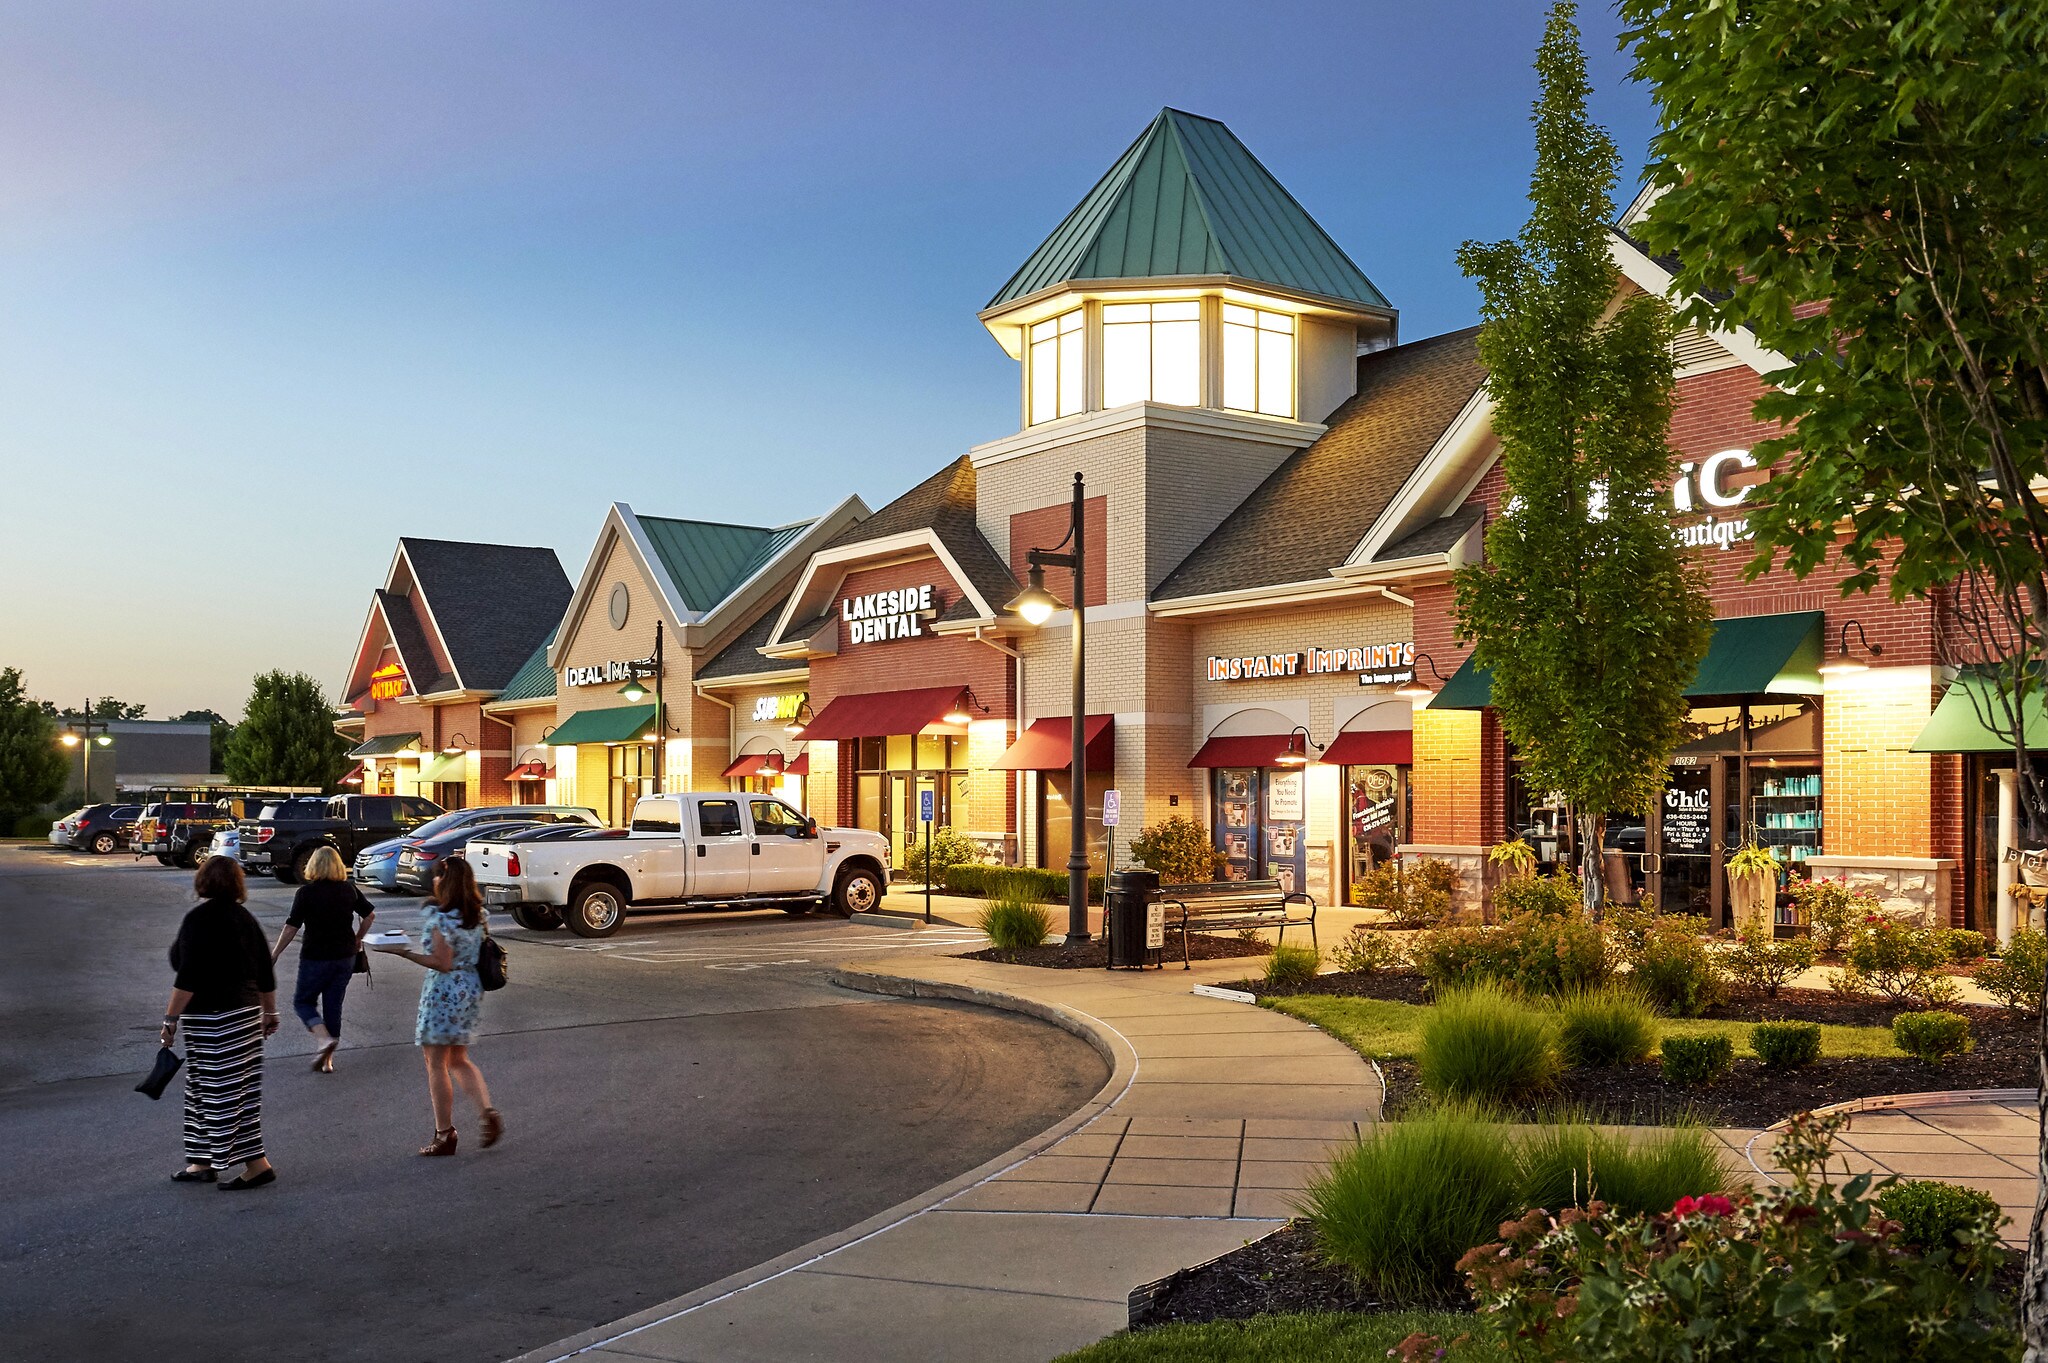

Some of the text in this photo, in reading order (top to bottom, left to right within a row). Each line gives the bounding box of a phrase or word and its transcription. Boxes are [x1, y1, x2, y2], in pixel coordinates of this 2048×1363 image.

[843, 584, 931, 621] LAKESIDE
[851, 613, 921, 644] DENTAL
[1207, 642, 1414, 681] INSTANT IMPRINTS
[565, 665, 602, 687] IDEAL
[1360, 674, 1373, 684] The
[1373, 673, 1393, 684] image
[371, 680, 403, 699] OUTBACK
[752, 692, 805, 722] SUBWAY
[1675, 757, 1696, 765] 3082
[1275, 778, 1297, 788] Everything
[1367, 774, 1390, 786] OPEN
[1284, 788, 1297, 796] Need
[1279, 798, 1297, 806] Promote
